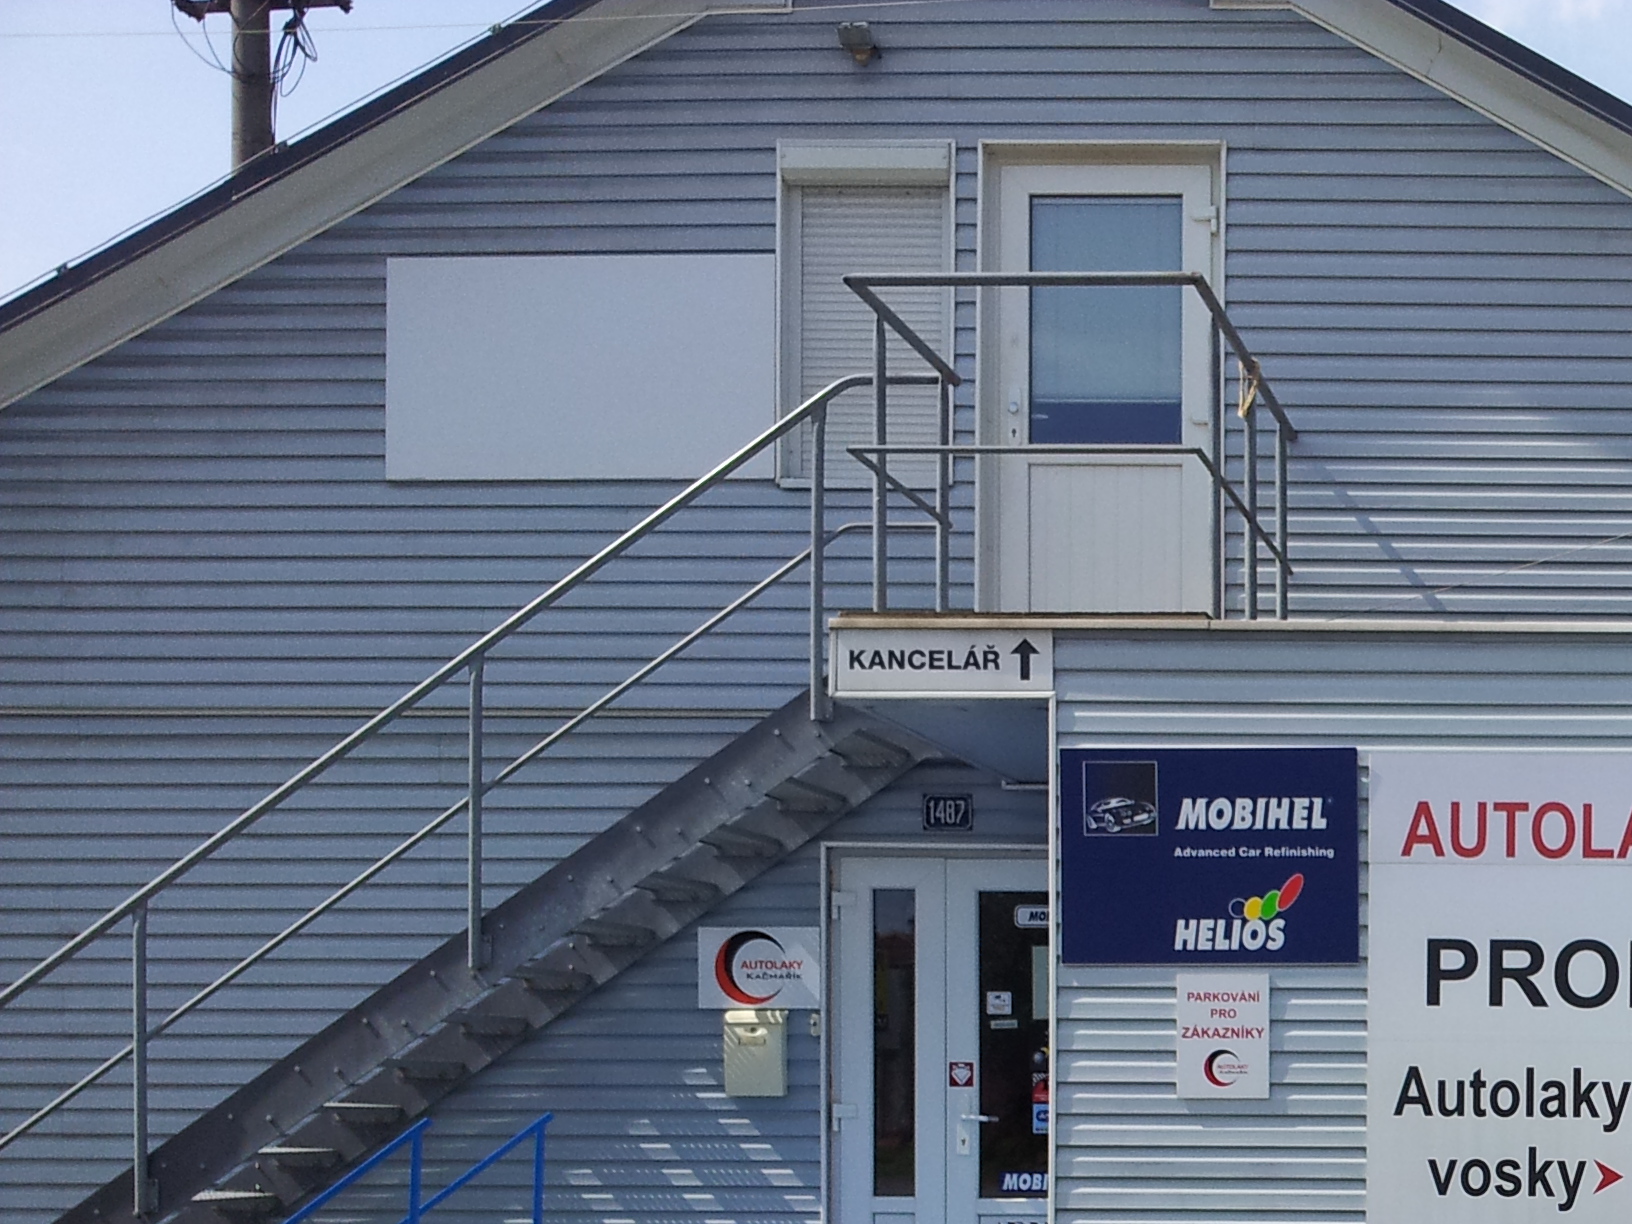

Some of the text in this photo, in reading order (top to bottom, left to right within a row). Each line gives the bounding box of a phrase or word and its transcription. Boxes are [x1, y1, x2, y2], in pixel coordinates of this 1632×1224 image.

[849, 644, 1000, 670] KANCELÁŘ
[929, 799, 966, 825] 1487
[1175, 797, 1328, 830] MOBIHEL
[1174, 847, 1335, 859] Advanced Car Refinishing
[1174, 918, 1286, 951] HELIOS
[741, 960, 803, 970] AUTOLAKY
[1186, 990, 1260, 1003] PARKOVÁNÍ
[1210, 1008, 1237, 1019] PRO
[1181, 1024, 1265, 1039] ZÁKAZNÍKY
[1393, 1066, 1632, 1133] Autolaky
[1002, 1173, 1048, 1191] MOBI
[1427, 1146, 1587, 1212] vosky
